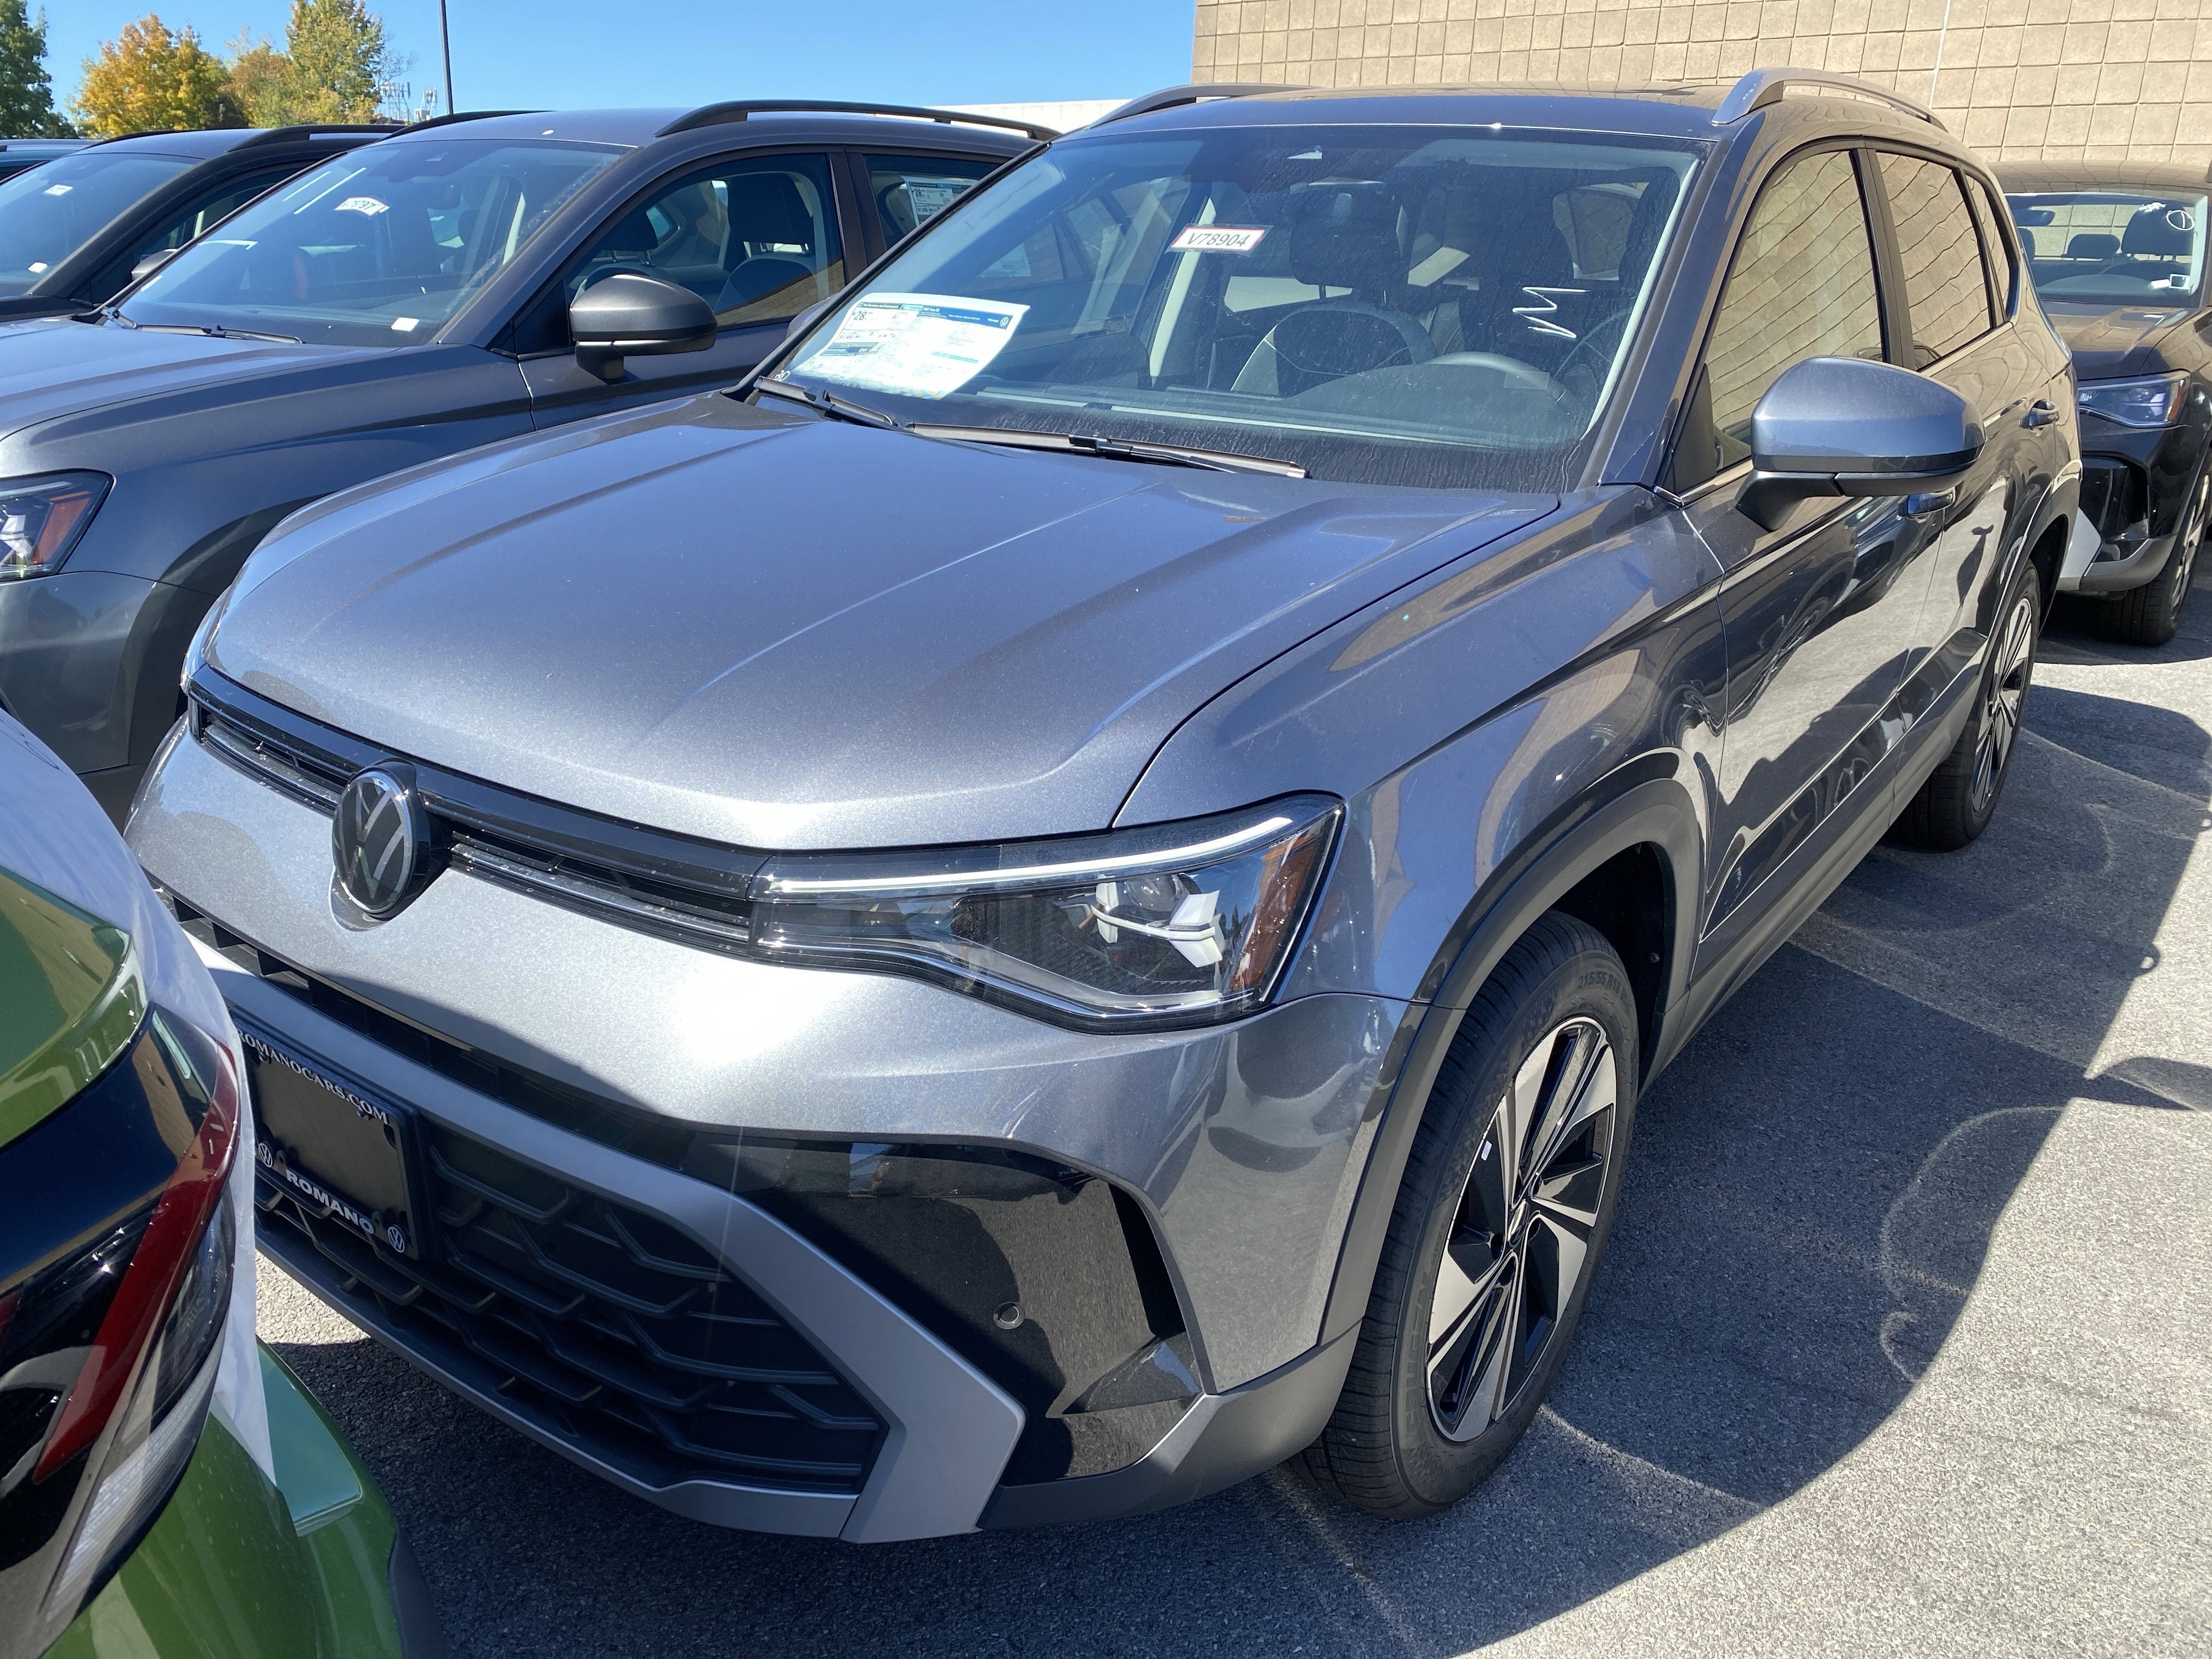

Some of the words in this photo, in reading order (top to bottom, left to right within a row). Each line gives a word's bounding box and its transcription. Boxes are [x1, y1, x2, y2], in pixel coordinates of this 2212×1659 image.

[1187, 233, 1251, 247] V78904
[853, 311, 867, 320] 28
[238, 1029, 388, 1125] ROMANOCARS.COM
[285, 1169, 374, 1234] ROMANO
